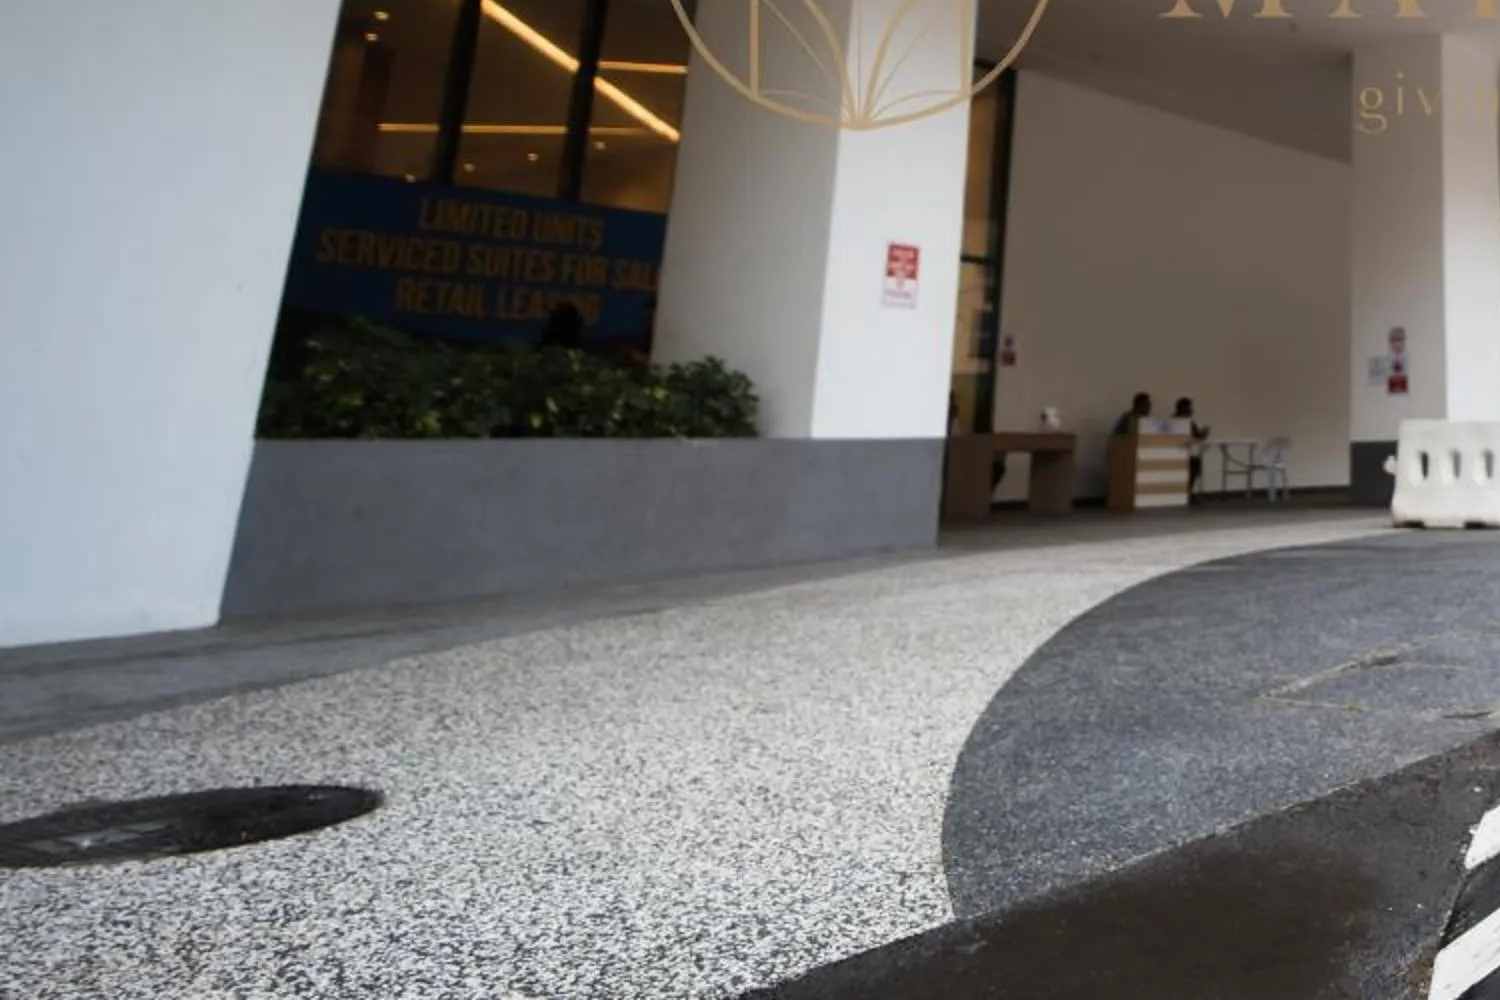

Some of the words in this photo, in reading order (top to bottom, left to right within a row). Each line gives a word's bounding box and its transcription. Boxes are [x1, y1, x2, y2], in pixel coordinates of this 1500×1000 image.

[419, 199, 527, 239] LIMITED
[533, 212, 604, 248] UNITS
[317, 229, 459, 272] SERVICED
[465, 244, 557, 284] SUITES
[561, 255, 608, 288] FOR
[612, 260, 659, 291] SAL
[395, 278, 486, 317] RETAIL
